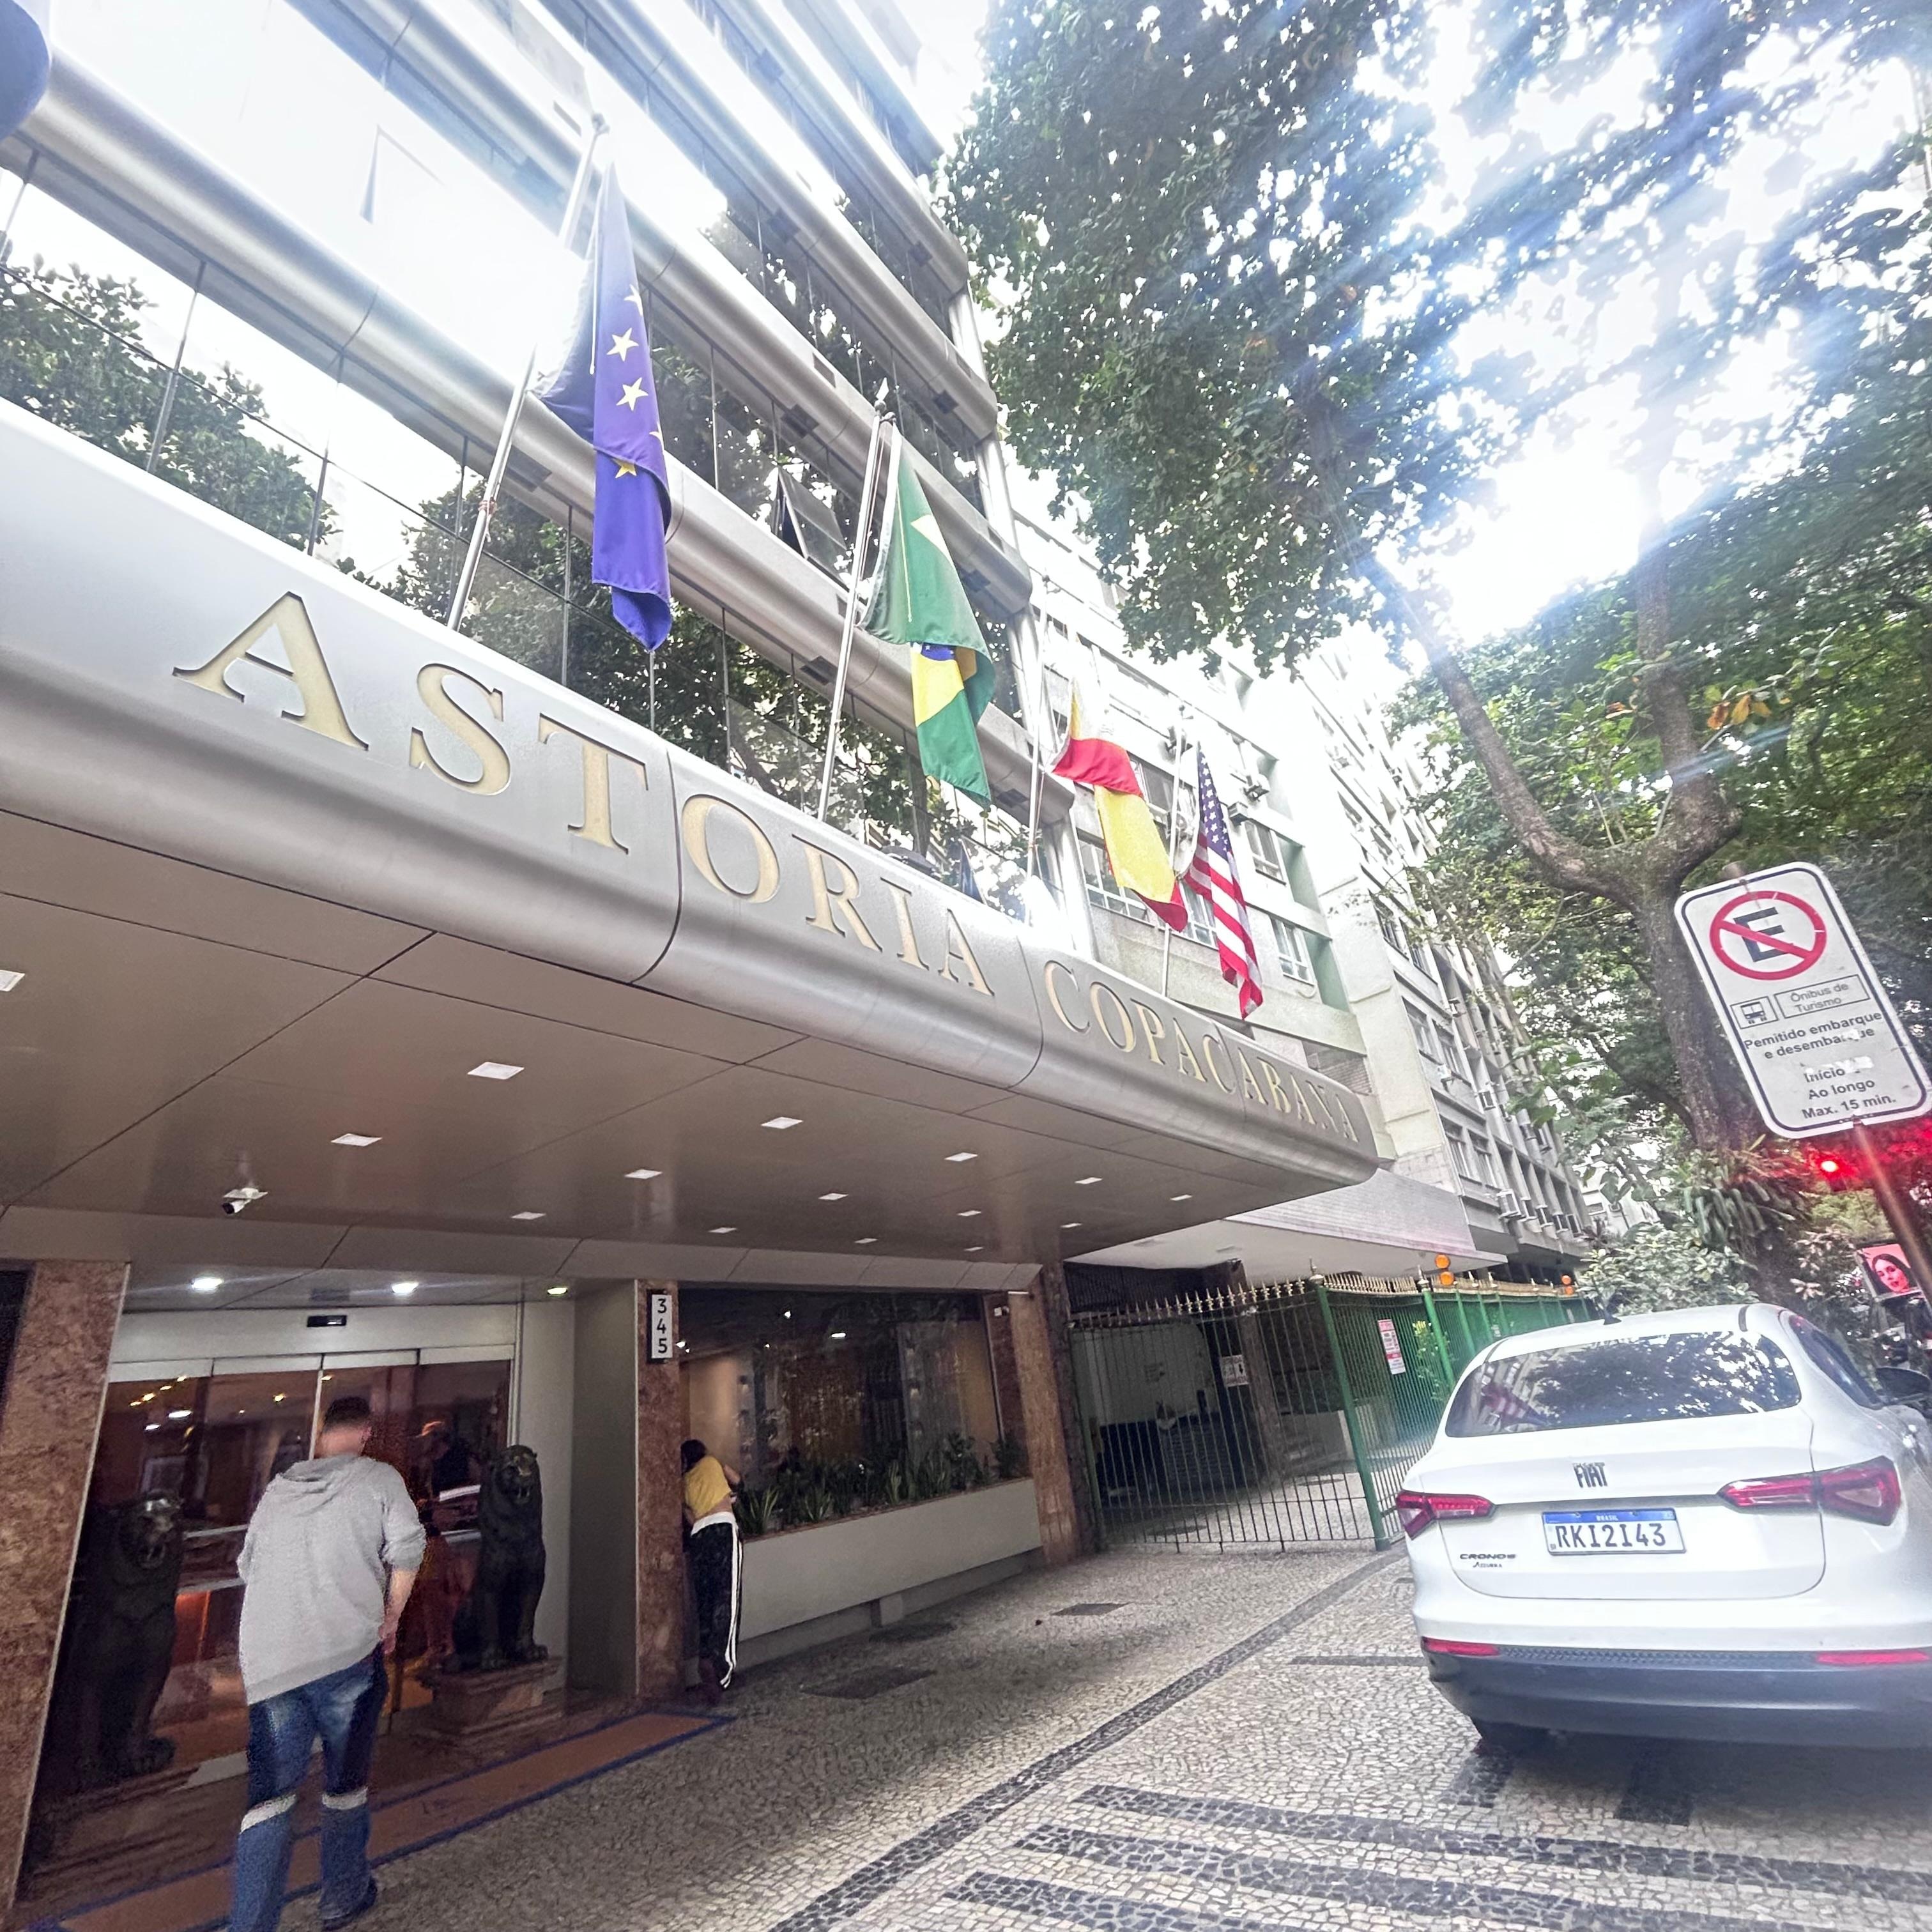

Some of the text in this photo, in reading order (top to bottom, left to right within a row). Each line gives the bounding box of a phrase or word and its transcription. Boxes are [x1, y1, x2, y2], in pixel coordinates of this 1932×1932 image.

[173, 591, 1359, 1143] ASTORIA COPACABANA
[1790, 984, 1849, 1002] Ônibus de
[1795, 997, 1841, 1012] Turismo
[1809, 1012, 1883, 1034] embarque
[1809, 1080, 1875, 1100] Ao longo
[1802, 1094, 1896, 1119] Max. 15 min.
[1572, 1462, 1608, 1488] FIAT
